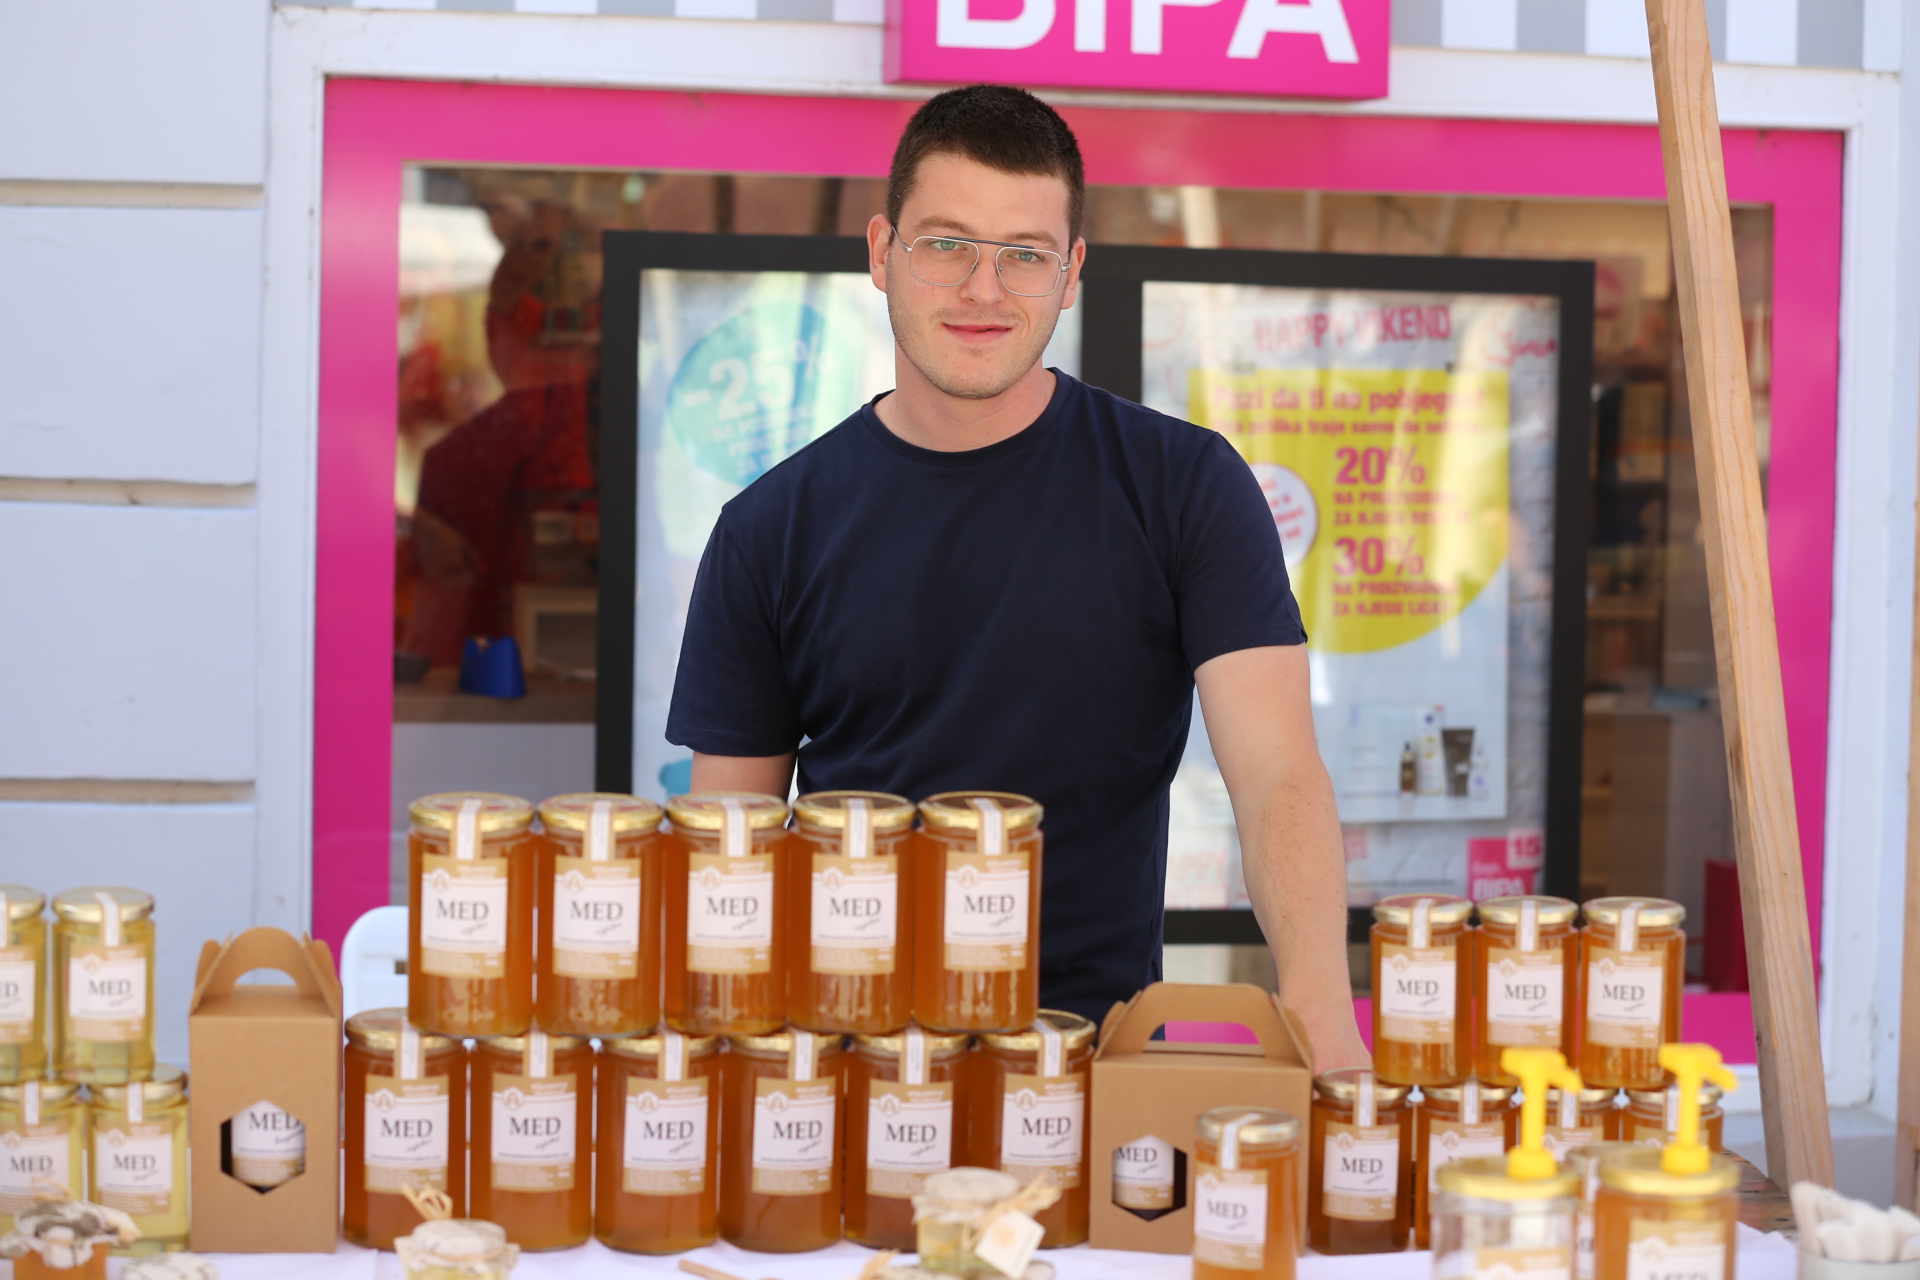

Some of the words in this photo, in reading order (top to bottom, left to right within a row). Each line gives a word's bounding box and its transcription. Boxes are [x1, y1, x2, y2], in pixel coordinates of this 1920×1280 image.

[1335, 445, 1427, 487] 20%
[1333, 535, 1425, 577] 30%
[437, 899, 489, 920] MED
[570, 900, 624, 920] MED
[706, 896, 759, 916] MED
[829, 897, 882, 916] MED
[964, 894, 1015, 913] MED
[88, 979, 132, 996] MED
[1397, 978, 1439, 996] MED
[1504, 983, 1547, 1001] MED
[1602, 984, 1645, 1002] MED
[248, 1111, 300, 1130] MED
[381, 1118, 434, 1138] MED
[509, 1116, 561, 1136] MED
[643, 1120, 694, 1139] MED
[772, 1120, 823, 1139] MED
[1021, 1116, 1072, 1135] MED
[885, 1123, 937, 1142] MED
[9, 1154, 53, 1173] MED
[113, 1153, 156, 1171] MED
[1116, 1146, 1158, 1162] MED
[1341, 1157, 1383, 1174] MED
[1206, 1200, 1248, 1219] MED
